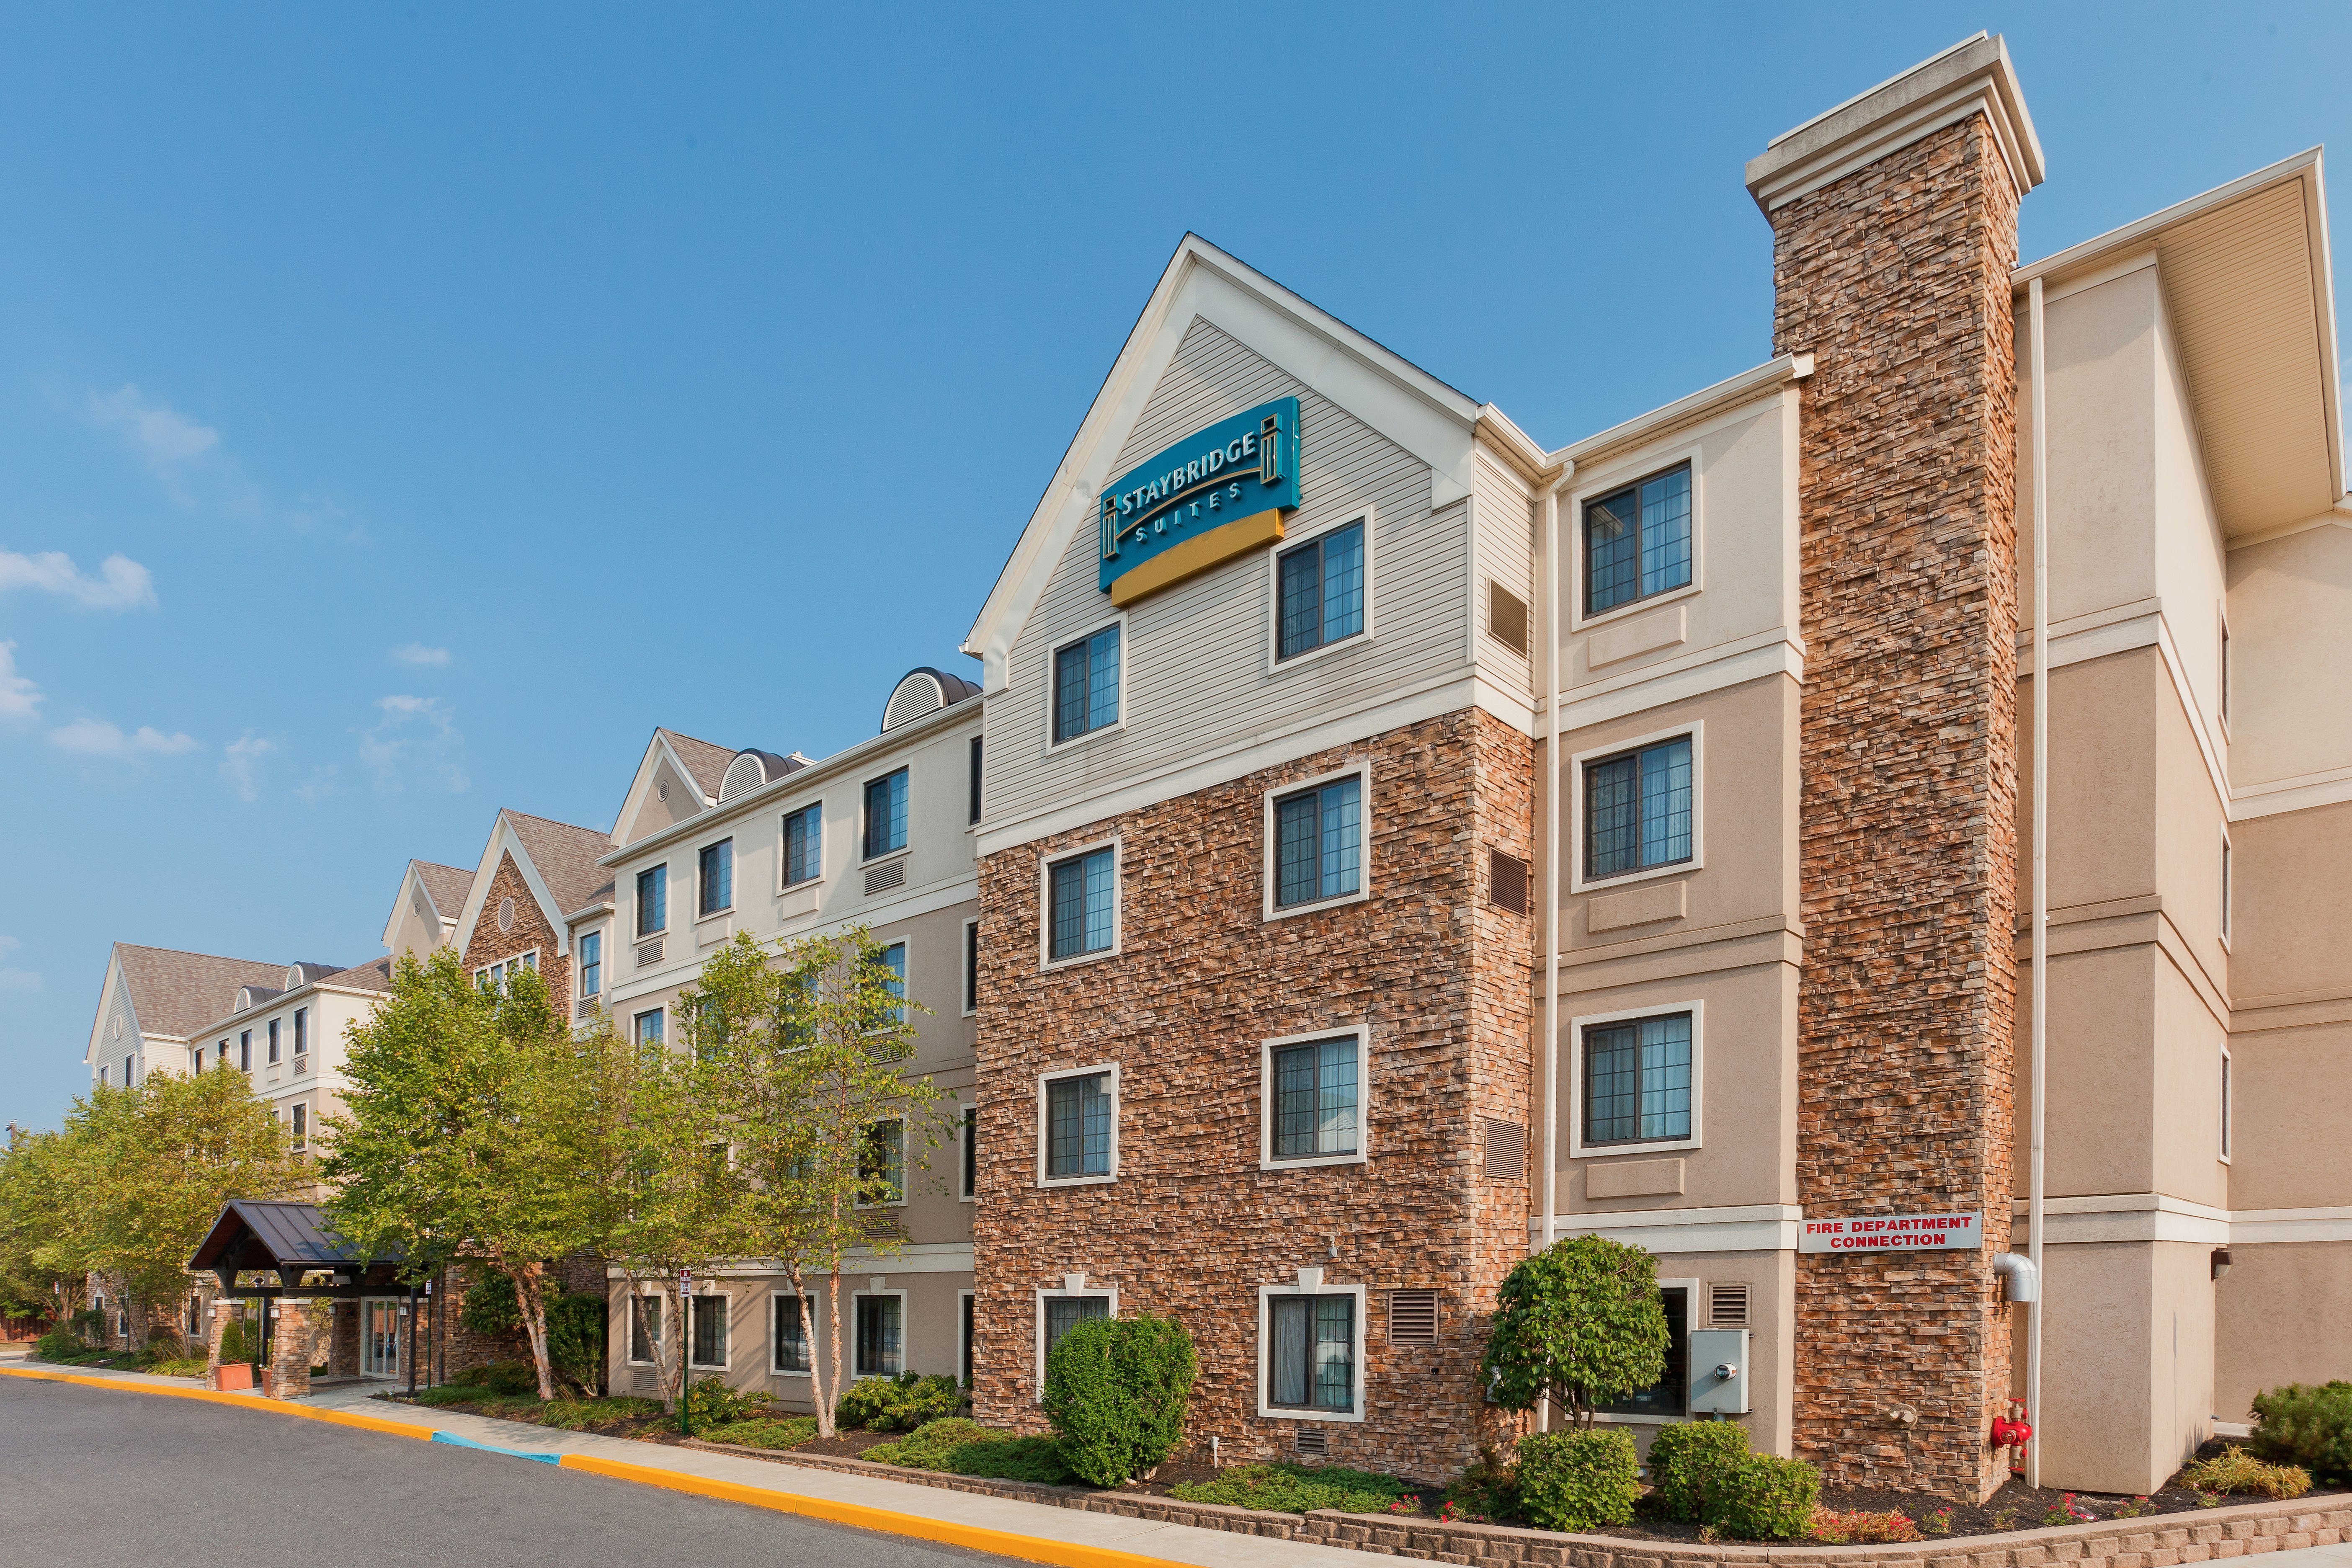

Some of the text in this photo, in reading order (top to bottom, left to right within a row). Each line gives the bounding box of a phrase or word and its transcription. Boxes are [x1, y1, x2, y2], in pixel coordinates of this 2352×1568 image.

[1122, 431, 1256, 515] STAYBRIDGE
[1136, 482, 1241, 542] SUITES
[1807, 1217, 1972, 1234] FIRE DEPARTMENT
[1831, 1234, 1945, 1248] CONNECTION
